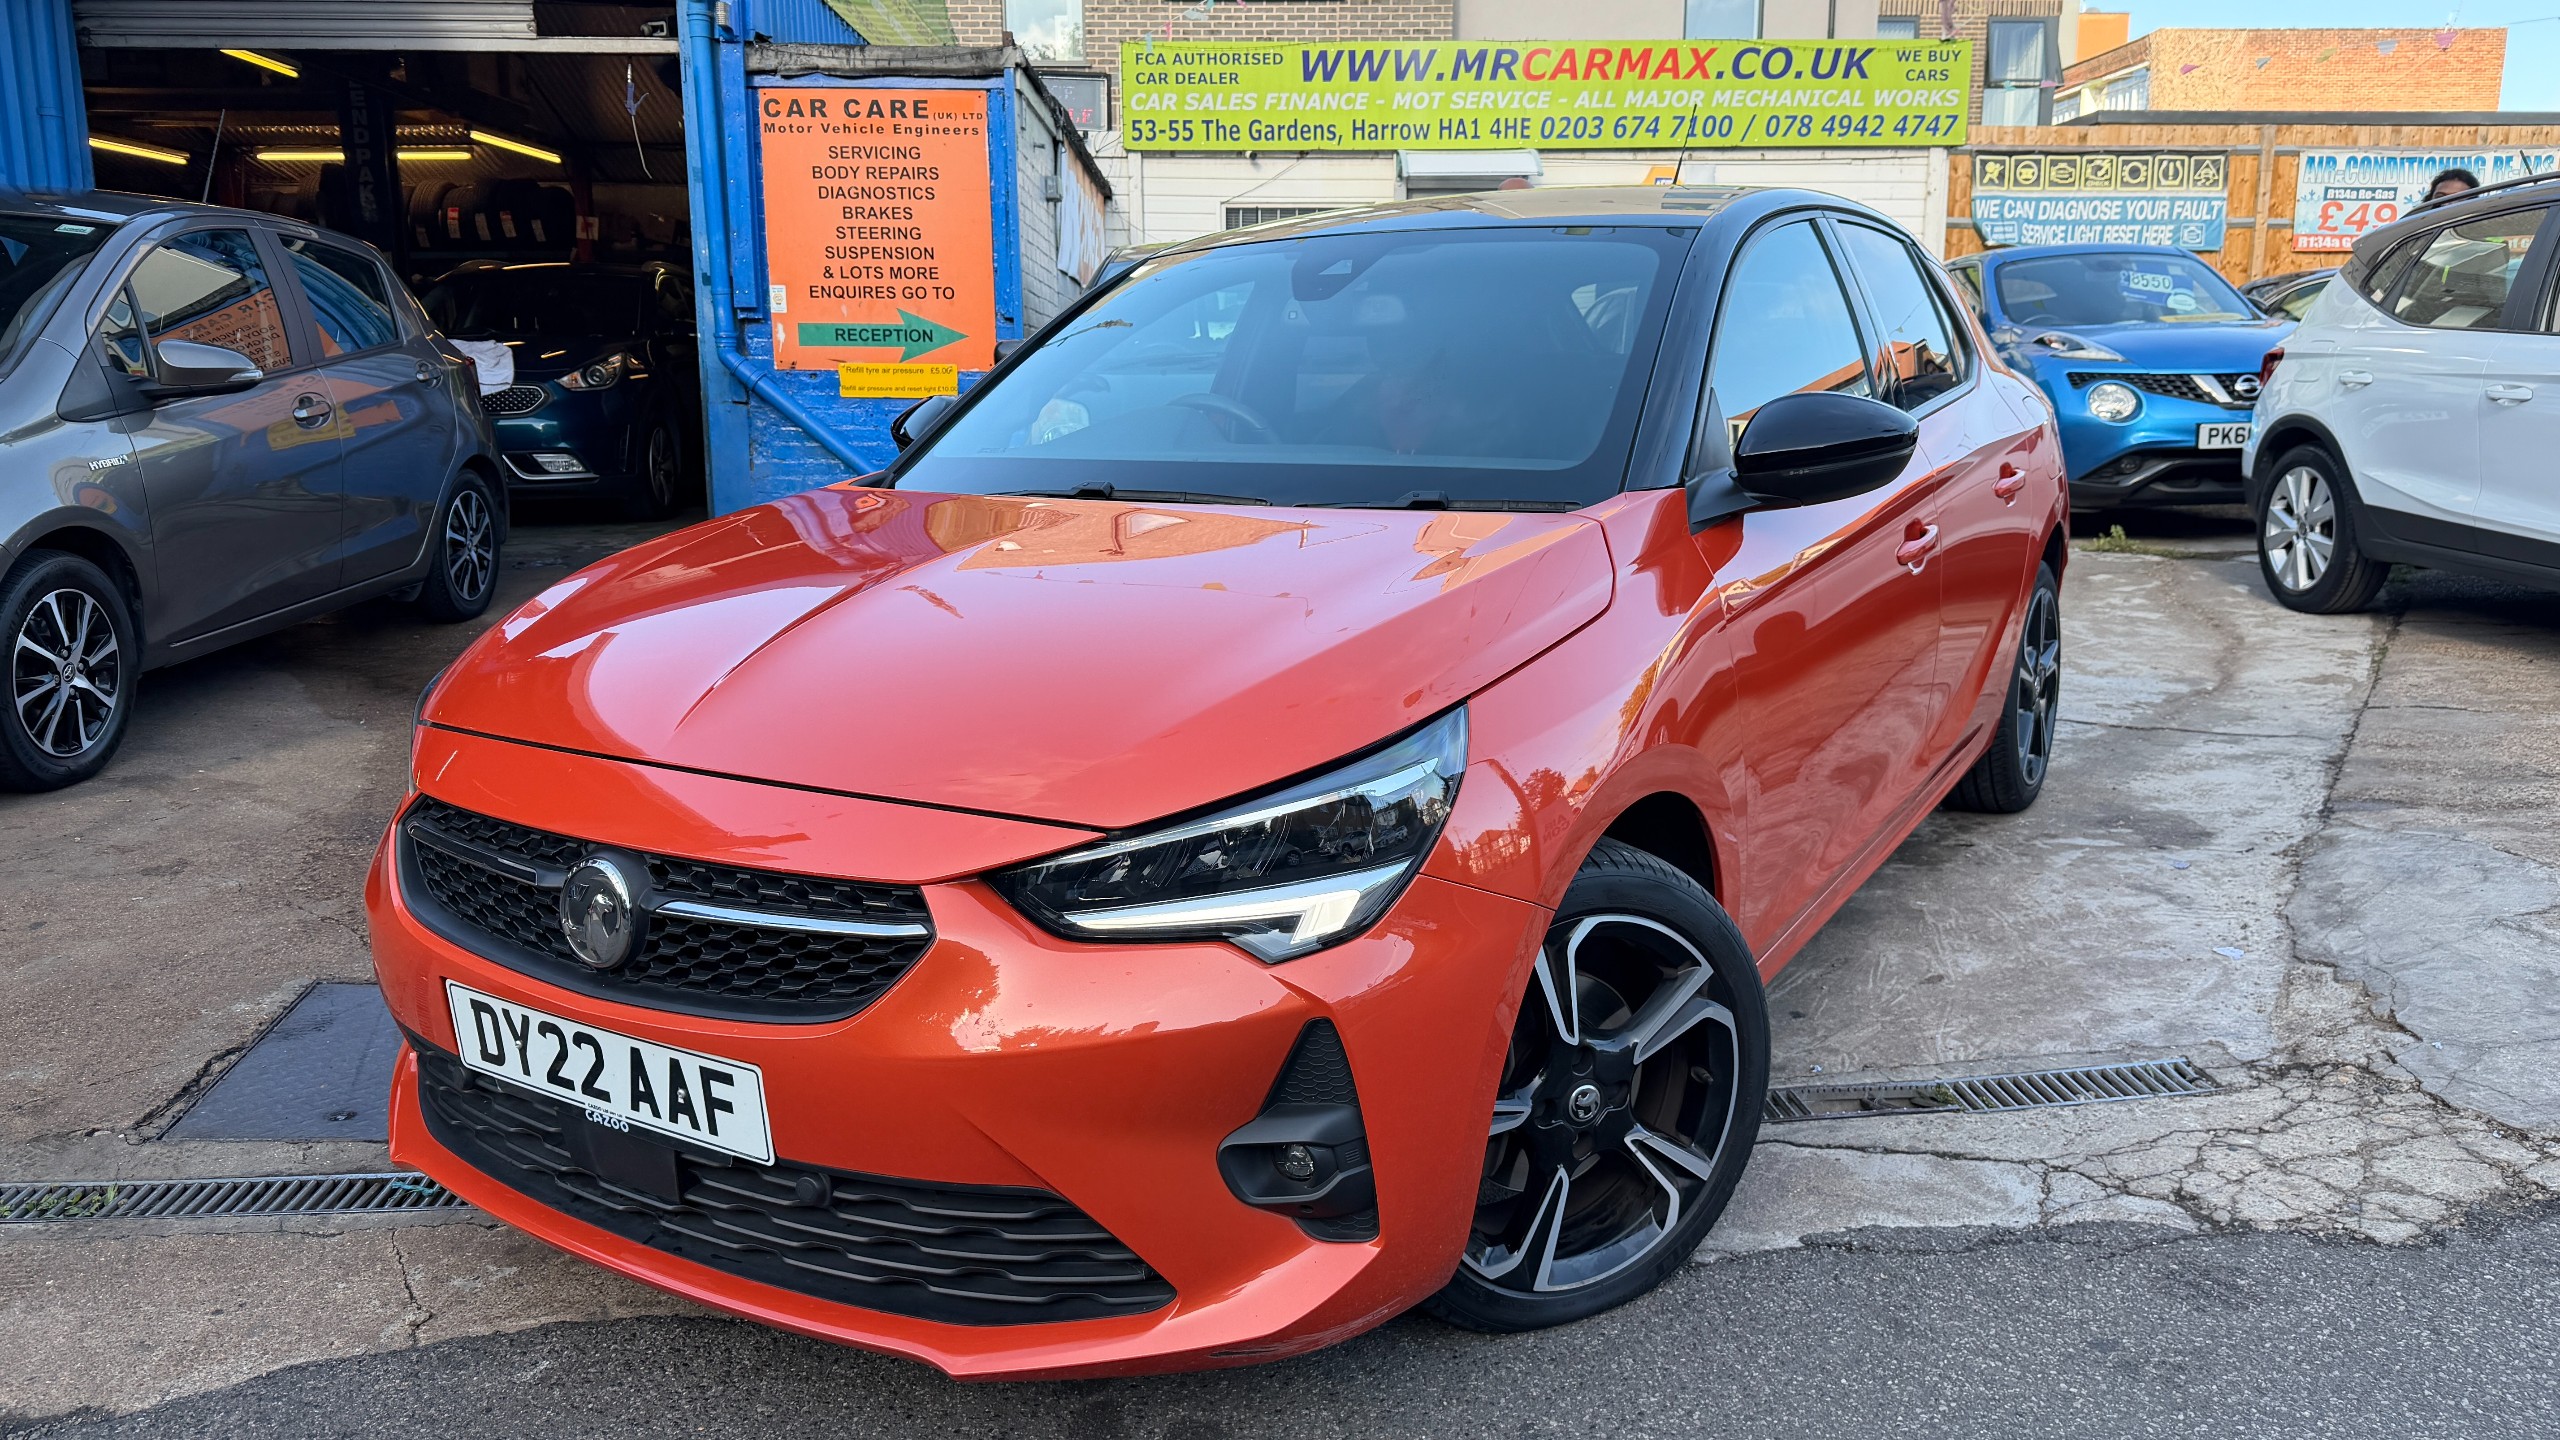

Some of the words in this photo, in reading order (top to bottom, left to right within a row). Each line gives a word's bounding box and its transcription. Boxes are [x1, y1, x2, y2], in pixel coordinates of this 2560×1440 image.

[1135, 53, 1168, 65] FCA
[1173, 52, 1284, 66] AUTHORISED
[1896, 50, 1924, 62] WE
[1928, 49, 1961, 62] BUY
[1302, 47, 1874, 82] WWW.MRCARMAX.CO.UK
[1135, 73, 1170, 85] CAR
[1174, 72, 1240, 85] DEALER
[1905, 69, 1949, 81] CARS
[1131, 93, 1177, 111] CAR
[1185, 92, 1256, 111] SALES
[1264, 92, 1369, 111] FINANCE
[1393, 91, 1445, 110] MOT
[1450, 90, 1551, 110] SERVICE
[1574, 90, 1616, 108] ALL
[1626, 90, 1706, 108] MAJOR
[1711, 89, 1863, 108] MECHANICAL
[1874, 89, 1959, 108] WORKS
[763, 98, 828, 118] CAR
[843, 98, 929, 119] CARE
[933, 112, 957, 121] (UK)
[962, 112, 983, 120] LTD
[763, 122, 813, 133] Motor
[820, 123, 885, 134] Vehicle
[893, 124, 979, 137] Engineers
[1132, 119, 1194, 142] 53-55
[1201, 119, 1240, 142] The
[1249, 118, 1343, 145] Gardens,
[1351, 118, 1430, 141] Harrow
[1439, 118, 1480, 140] HA1
[1490, 117, 1531, 140] 4HE
[1540, 116, 1604, 139] 0203
[1613, 115, 1660, 138] 674
[1672, 115, 1733, 138] 7100
[1740, 114, 1757, 142] /
[1765, 115, 1812, 138] 078
[1821, 114, 1884, 138] 4942
[1893, 114, 1958, 137] 4747
[828, 145, 921, 160] SERVICING
[812, 165, 860, 179] BODY
[866, 166, 939, 180] REPAIRS
[818, 186, 935, 200] DIAGNOSTICS
[2327, 188, 2358, 200] R134a
[2358, 189, 2395, 200] Re-Gas
[842, 206, 913, 220] BRAKES
[1975, 199, 2001, 219] WE
[2003, 199, 2036, 220] CAN
[2038, 200, 2123, 221] DIAGNOSE
[2126, 200, 2170, 221] YOUR
[836, 226, 922, 240] STEERING
[2021, 223, 2067, 245] SERVICE
[2067, 224, 2102, 244] LIGHT
[2103, 225, 2141, 245] RESET
[2142, 225, 2174, 246] HERE
[2298, 236, 2340, 248] R134a
[825, 245, 935, 260] SUSPENSION
[823, 265, 834, 279] &
[840, 266, 884, 279] LOTS
[889, 266, 940, 280] MORE
[809, 285, 896, 300] ENQUIRES
[902, 286, 927, 299] GO
[932, 286, 955, 300] TO
[835, 328, 934, 342] RECEPTION
[845, 366, 864, 374] Refill
[866, 367, 879, 375] tyre
[2207, 427, 2251, 445] PK6
[88, 457, 125, 471] HYBRID
[469, 998, 611, 1103] DY22
[630, 1046, 735, 1137] AAF
[585, 1109, 629, 1133] CAZOO
